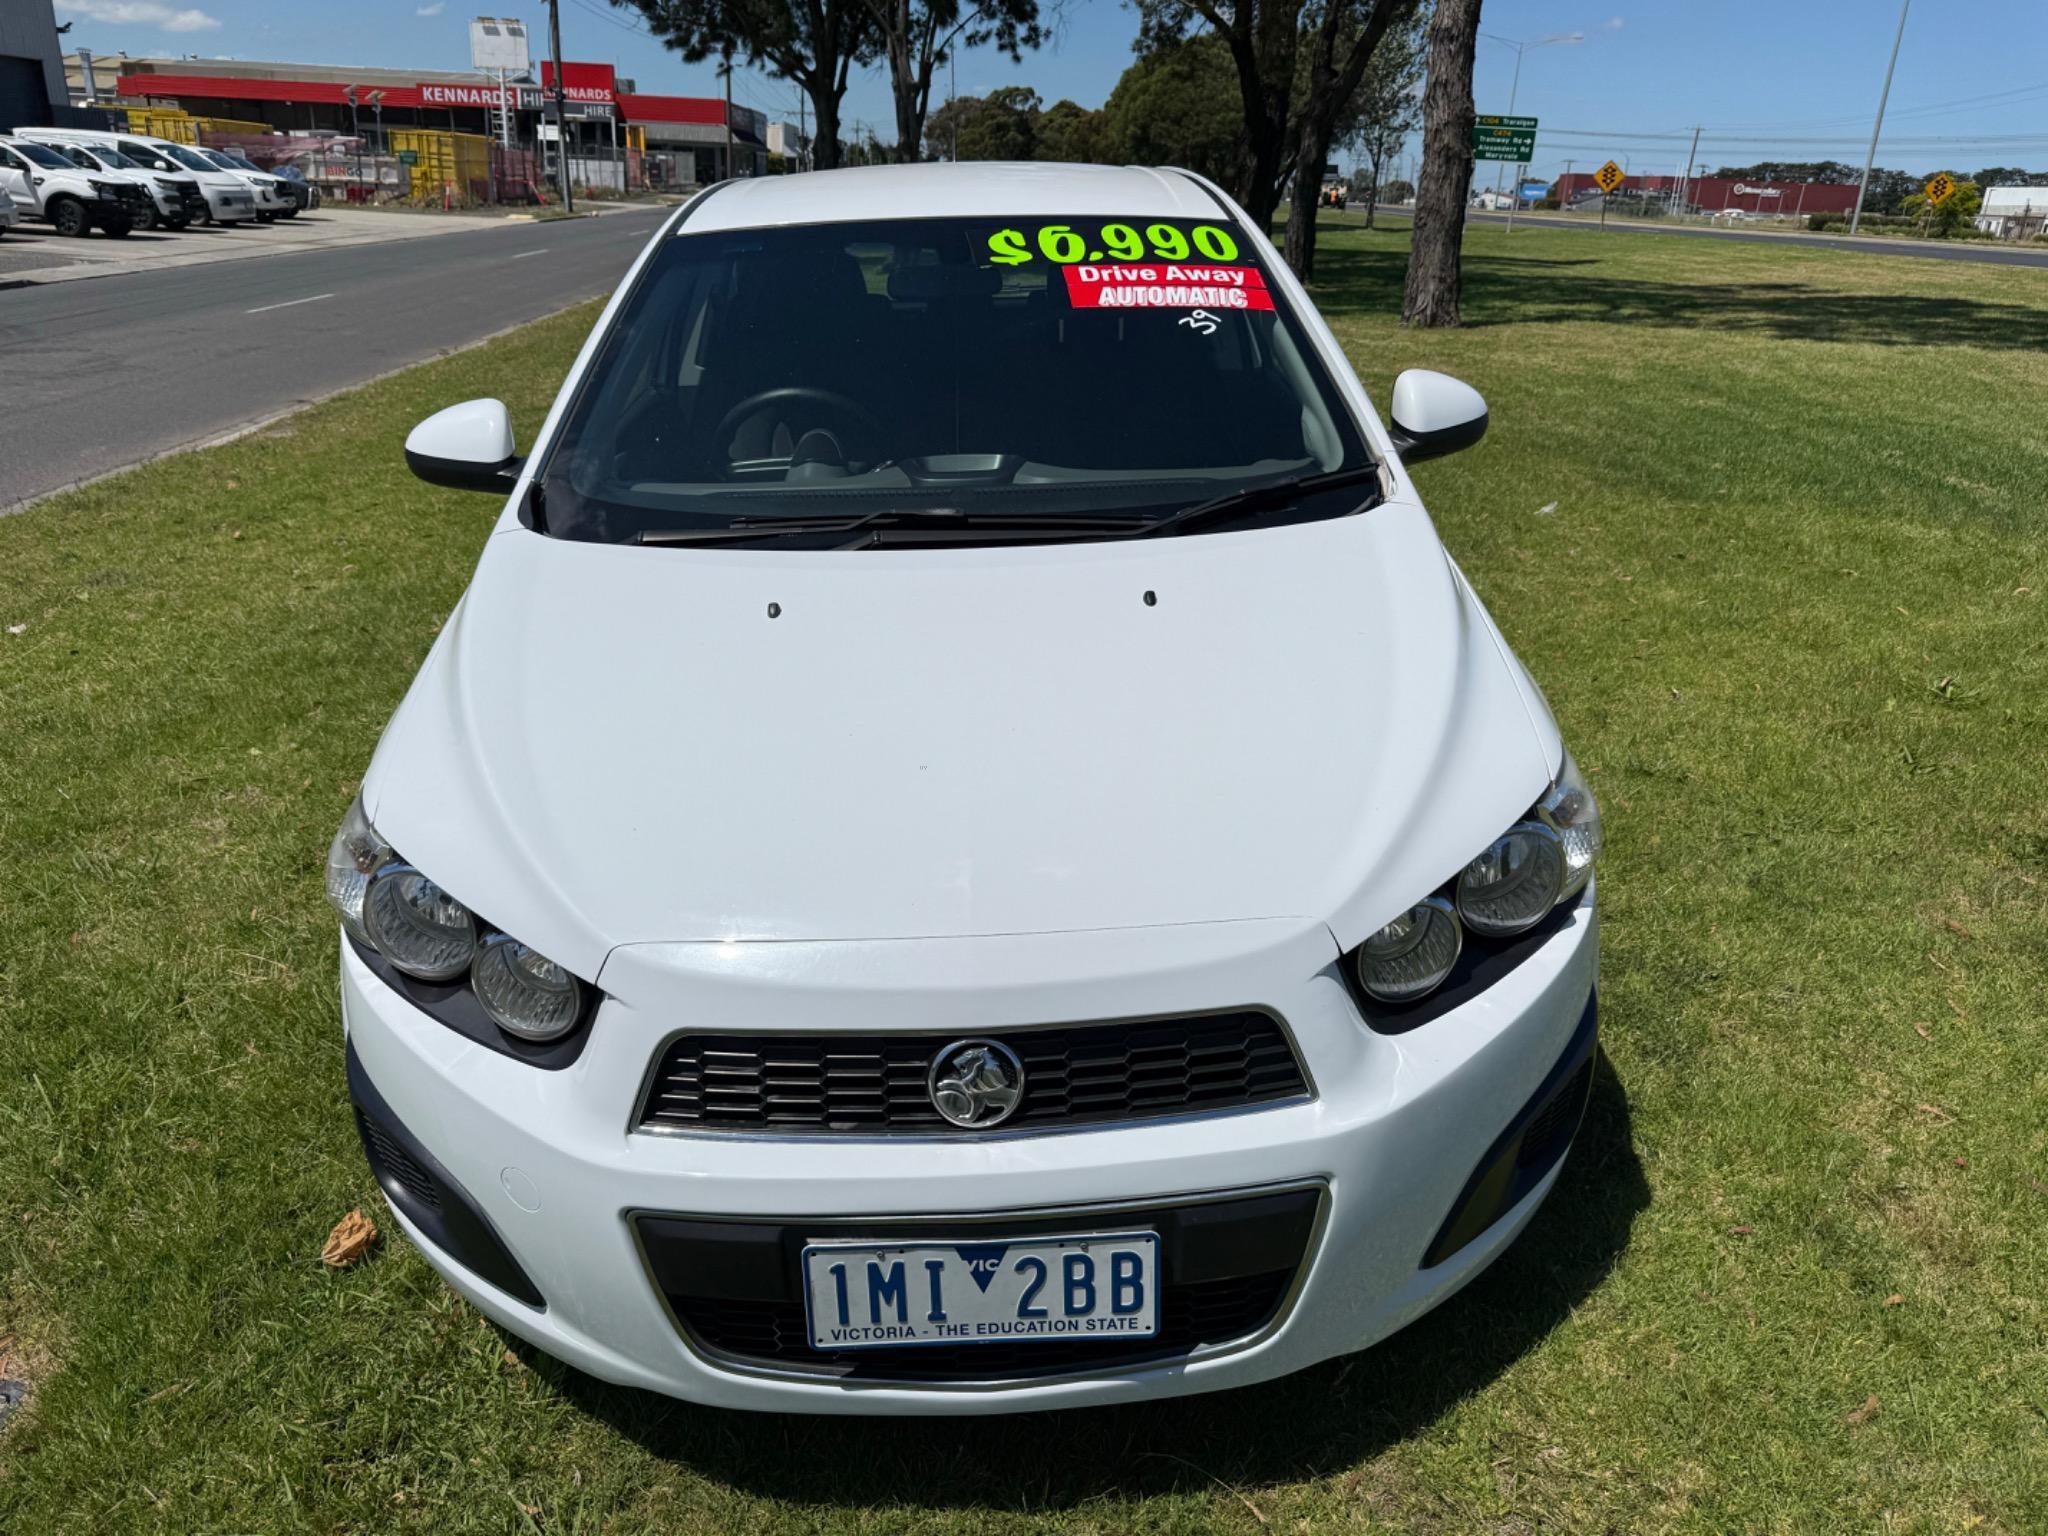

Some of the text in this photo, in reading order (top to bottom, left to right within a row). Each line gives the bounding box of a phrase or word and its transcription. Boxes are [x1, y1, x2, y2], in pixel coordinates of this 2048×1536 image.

[422, 86, 514, 105] KENNARDS
[584, 105, 611, 117] HIRE
[1504, 119, 1535, 127] Traralgon
[1480, 136, 1510, 144] Tramway
[327, 166, 362, 176] BINGO
[1080, 266, 1246, 285] Drive Away
[1097, 286, 1248, 308] AUTOMATIC
[966, 1258, 999, 1273] VIC
[827, 1250, 1146, 1327] 1MI 2BB
[831, 1325, 916, 1342] VICTORIA
[935, 1323, 970, 1337] THE
[976, 1319, 1080, 1335] EDUCATION
[1085, 1317, 1139, 1332] STATE
